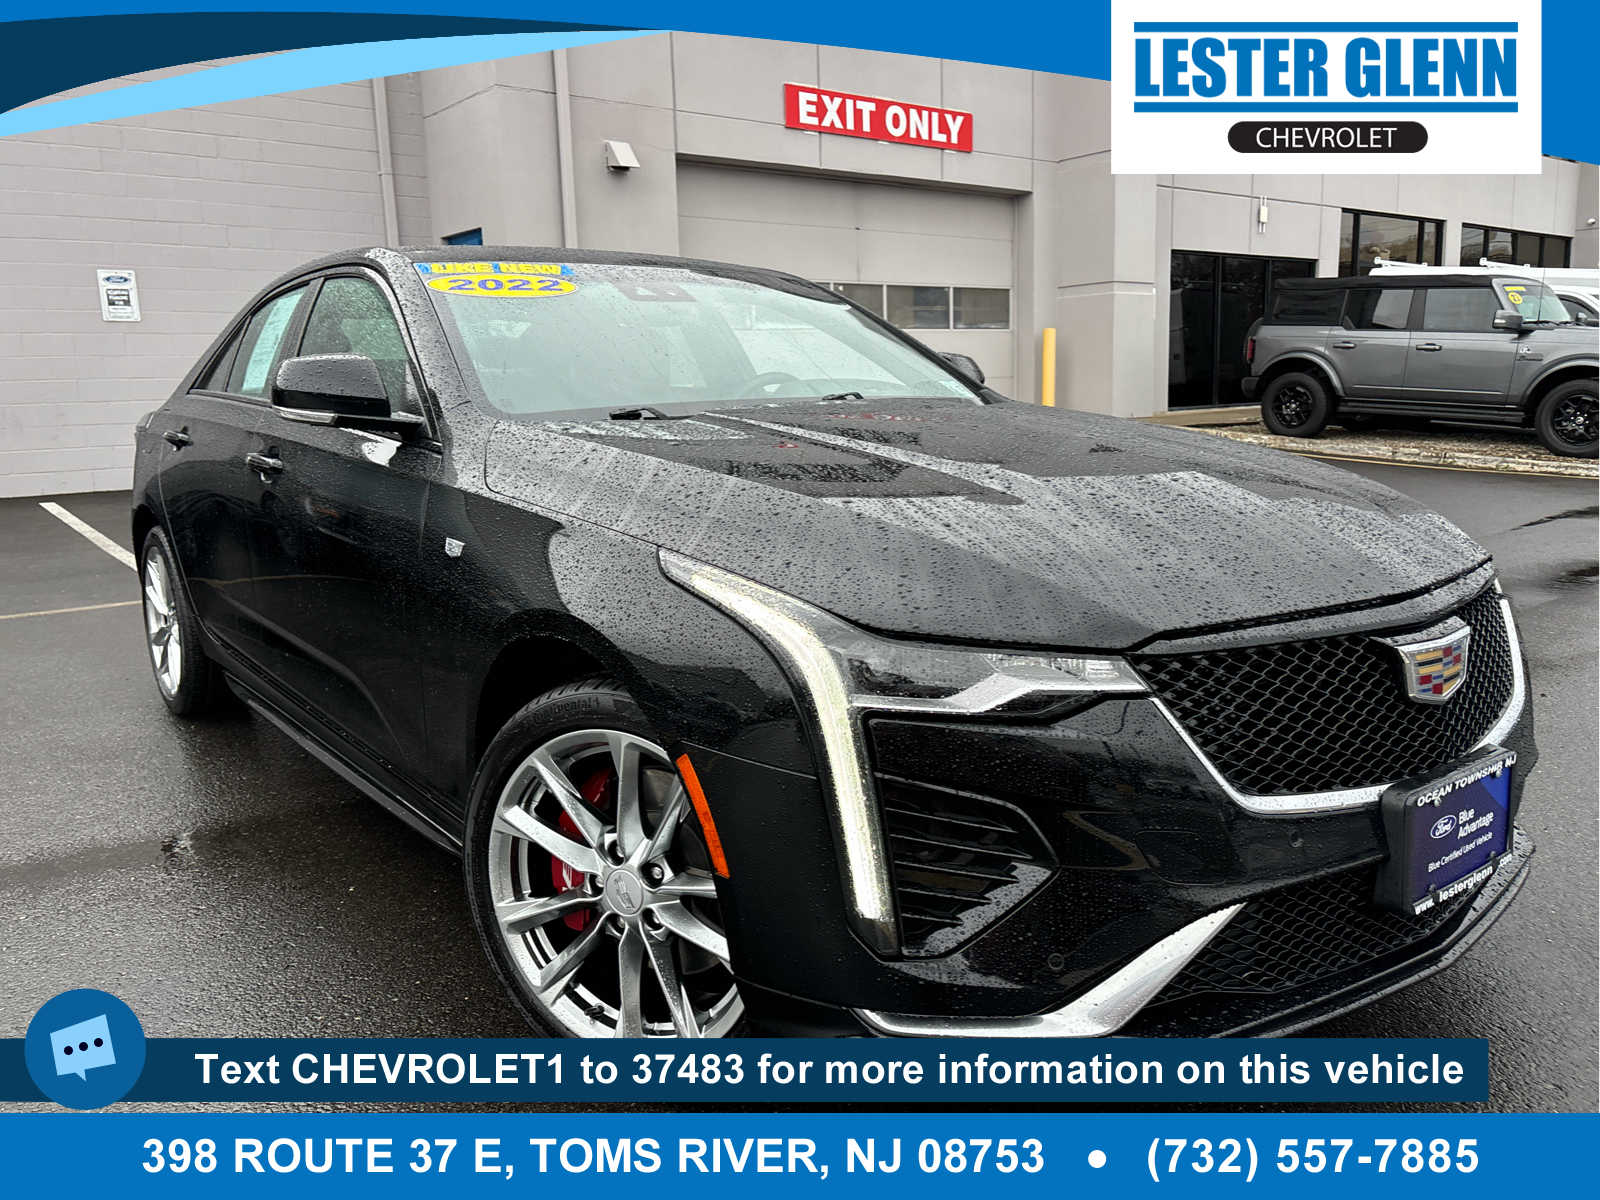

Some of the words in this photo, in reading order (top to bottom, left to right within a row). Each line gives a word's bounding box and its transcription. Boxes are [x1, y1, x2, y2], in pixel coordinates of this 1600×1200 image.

[798, 91, 876, 133] EXIT
[885, 105, 964, 145] ONLY
[448, 278, 563, 292] 2022
[1417, 783, 1453, 807] OCEAN
[1455, 761, 1503, 790] TOWNSHIP
[1504, 754, 1517, 768] NJ
[1457, 812, 1494, 840] Advantage
[1459, 808, 1475, 825] Blue
[1439, 865, 1493, 902] lesterglenn
